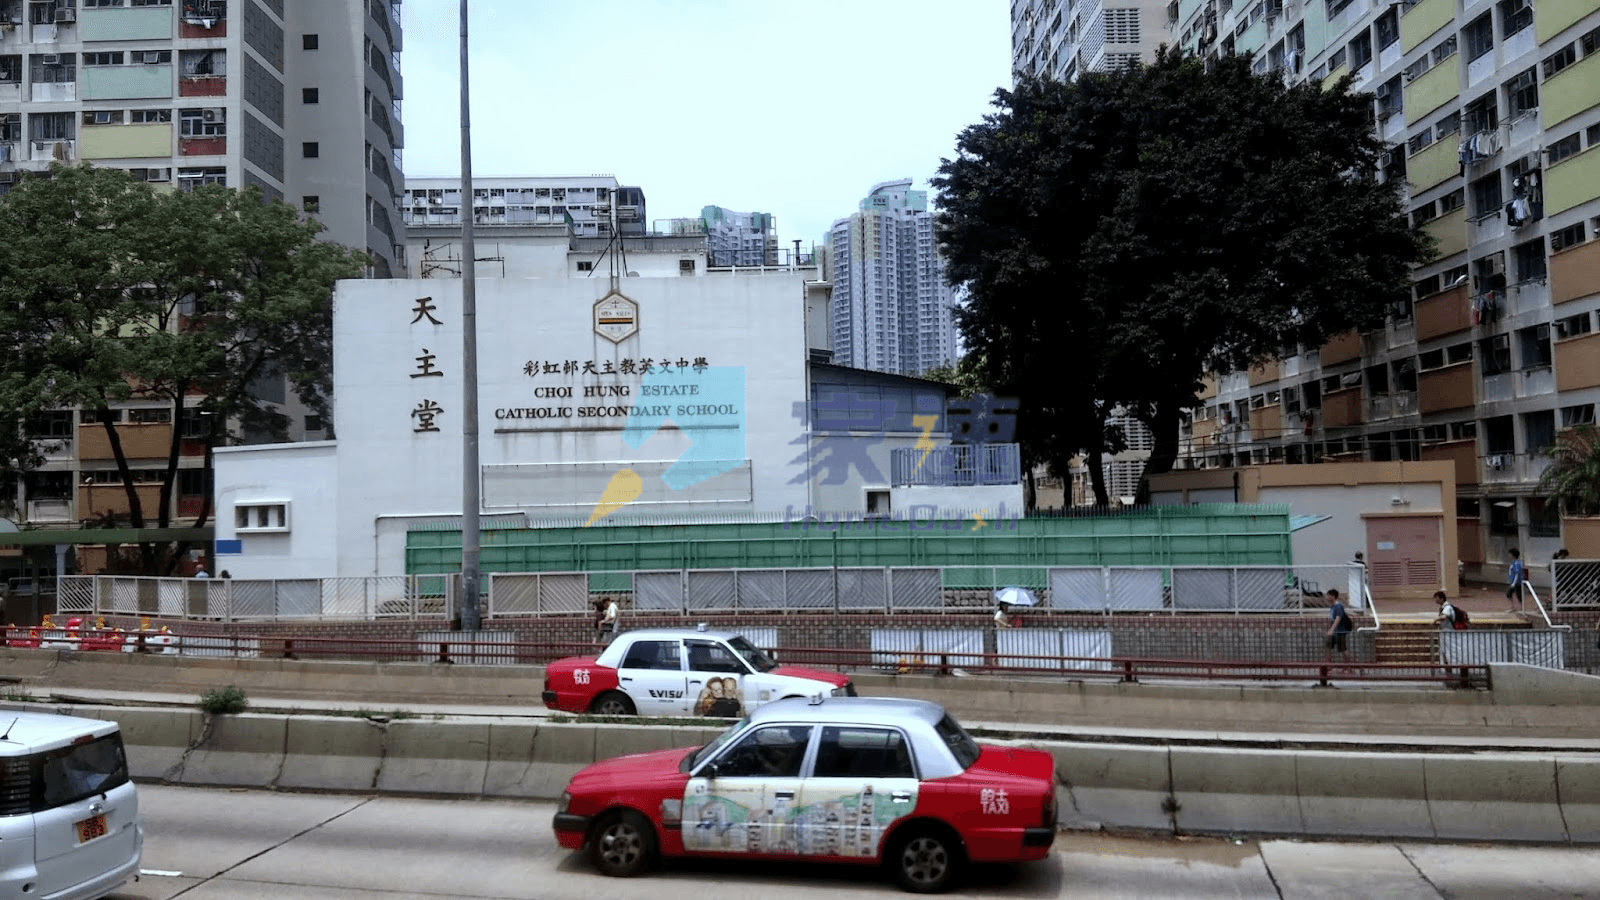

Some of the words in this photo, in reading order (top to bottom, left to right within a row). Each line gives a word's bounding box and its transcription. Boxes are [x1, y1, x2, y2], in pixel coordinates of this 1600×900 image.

[410, 296, 444, 433] 天主堂
[523, 357, 710, 377] 彩虹邨天主教英文中學
[534, 387, 573, 398] CHOI
[583, 386, 630, 397] HUNG
[641, 385, 699, 396] ESTATE
[495, 407, 572, 419] CATHOLIC
[577, 405, 672, 418] SECONDARY
[677, 404, 738, 416] SCHOOL
[649, 689, 684, 698] EVISU
[980, 788, 1008, 801] 的士
[980, 801, 1009, 814] TAXI
